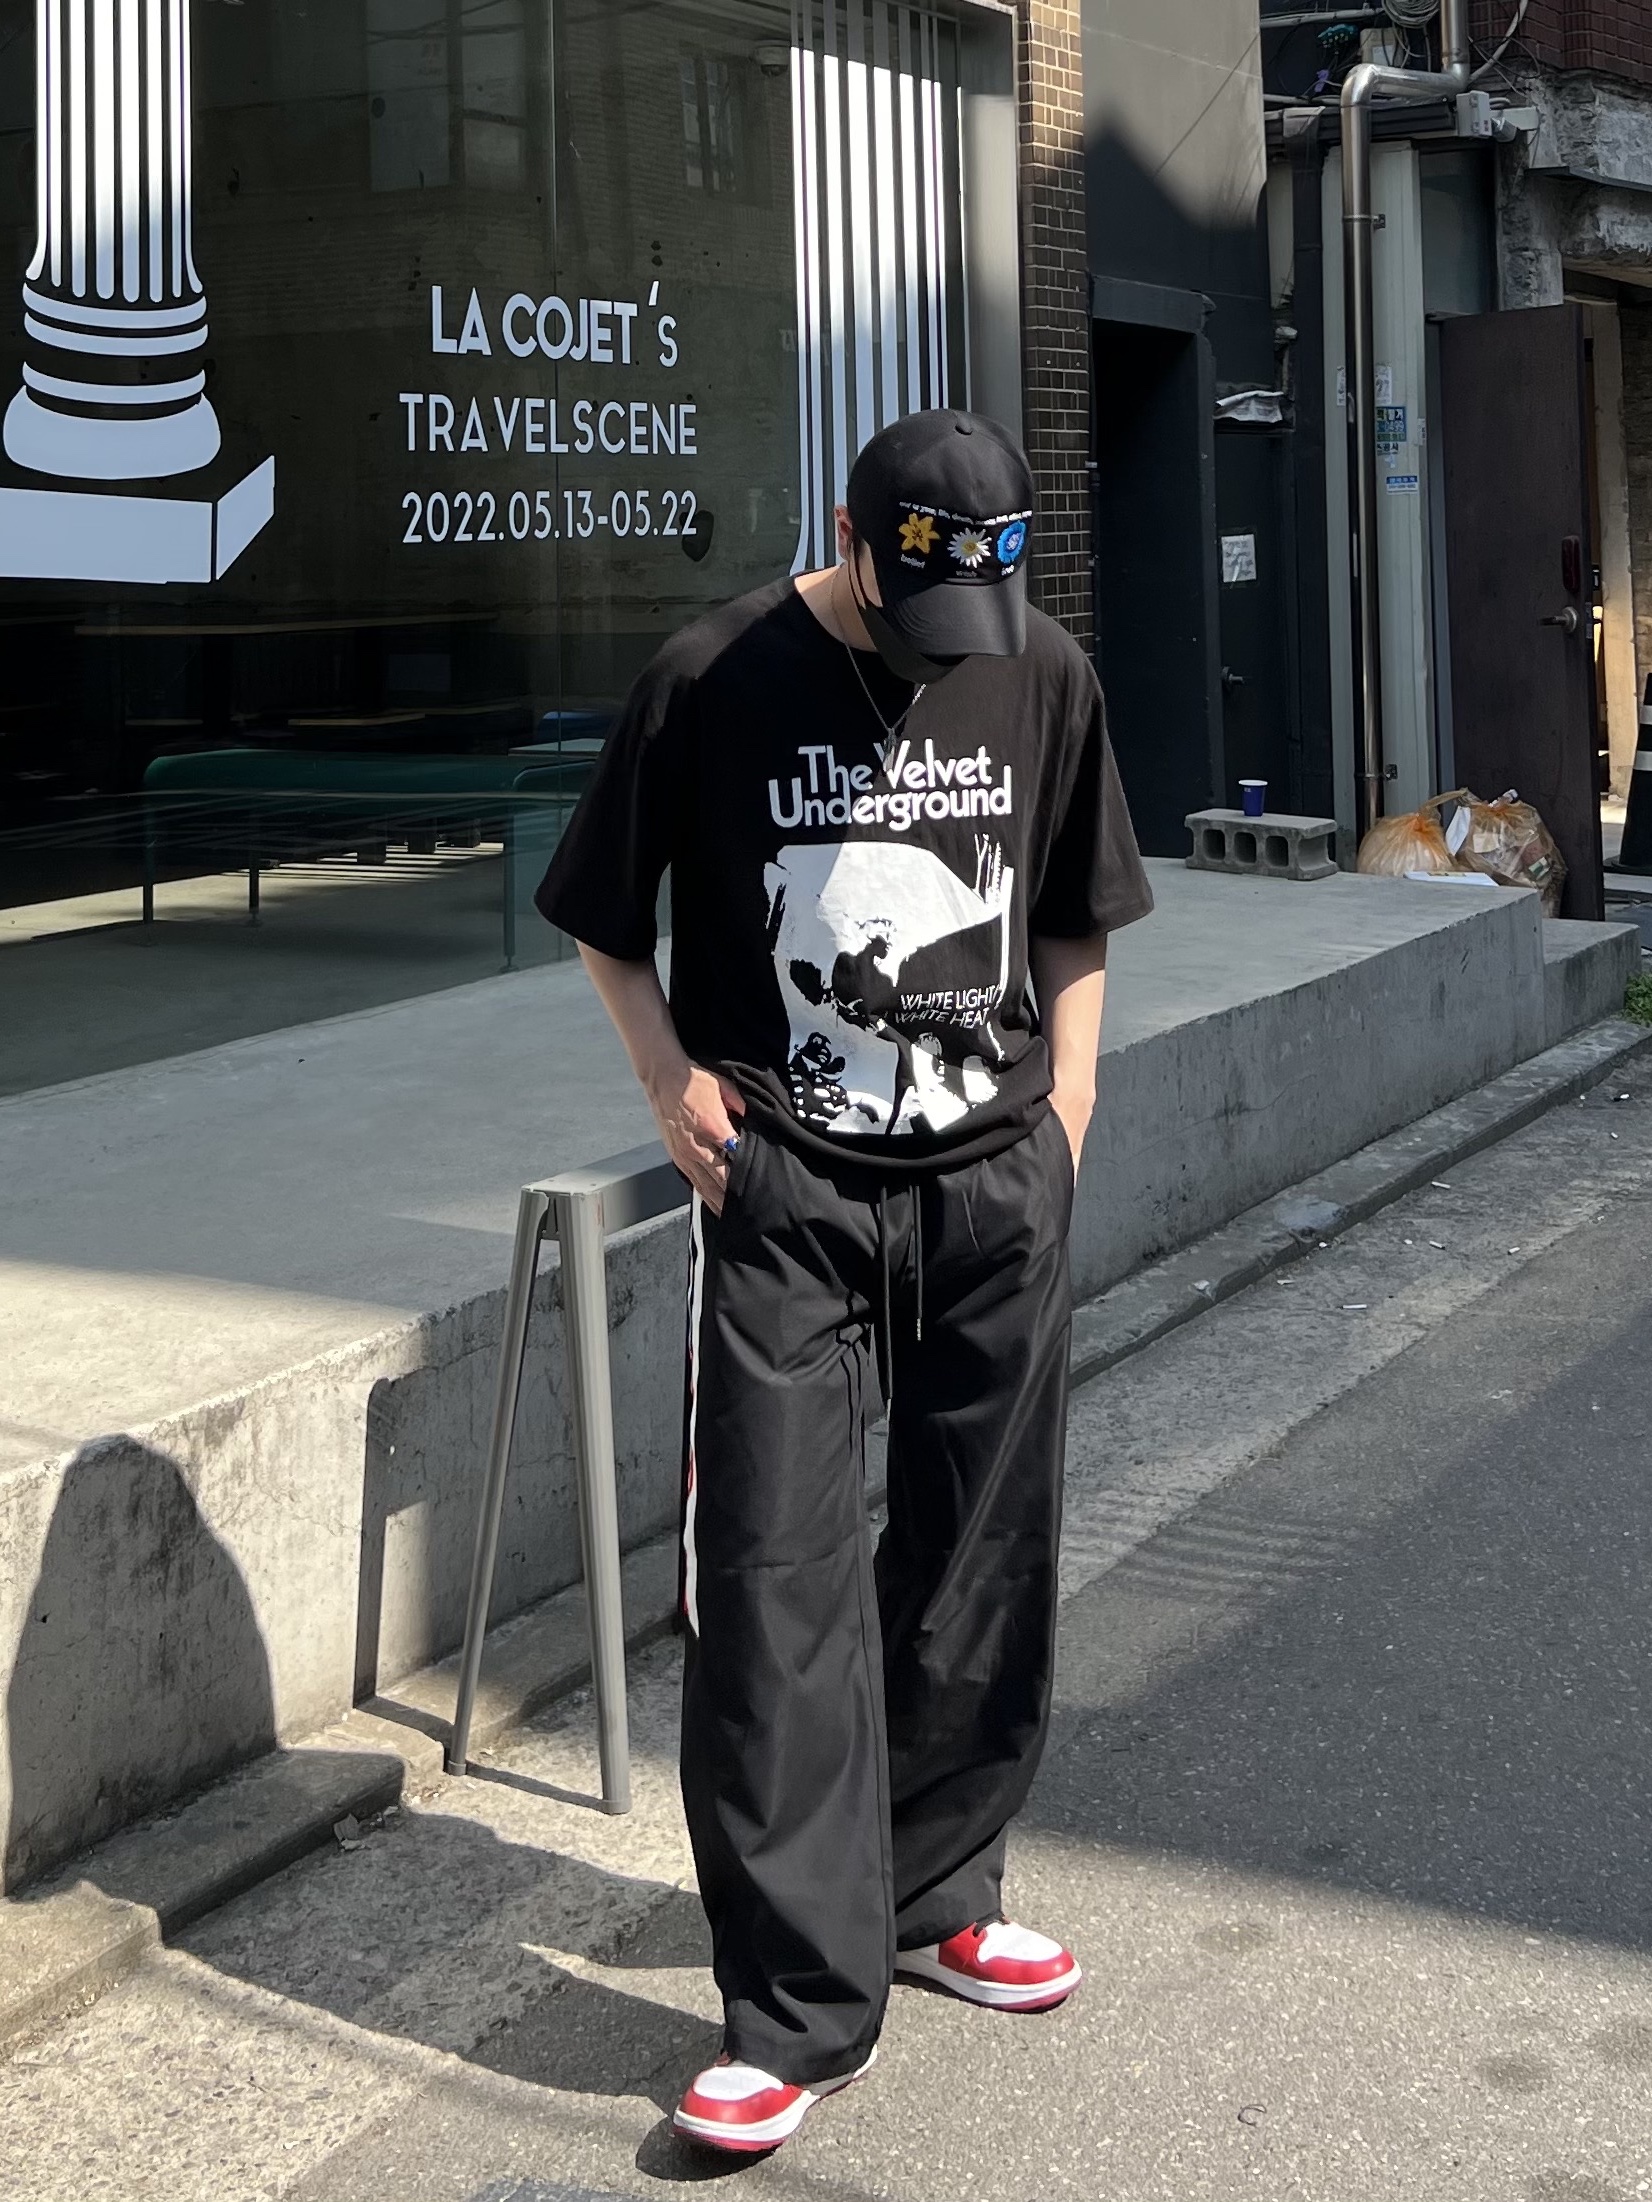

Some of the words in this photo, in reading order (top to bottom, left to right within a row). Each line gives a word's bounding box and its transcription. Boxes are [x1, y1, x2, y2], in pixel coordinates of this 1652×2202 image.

[431, 285, 493, 356] LA
[401, 489, 698, 544] 2022.05.13-05.22
[798, 744, 873, 794] The
[873, 738, 993, 790] Velvet
[768, 764, 1013, 832] Underground
[895, 1008, 950, 1024] WHITE
[949, 1006, 990, 1029] HEAT
[900, 990, 954, 1011] WHITE
